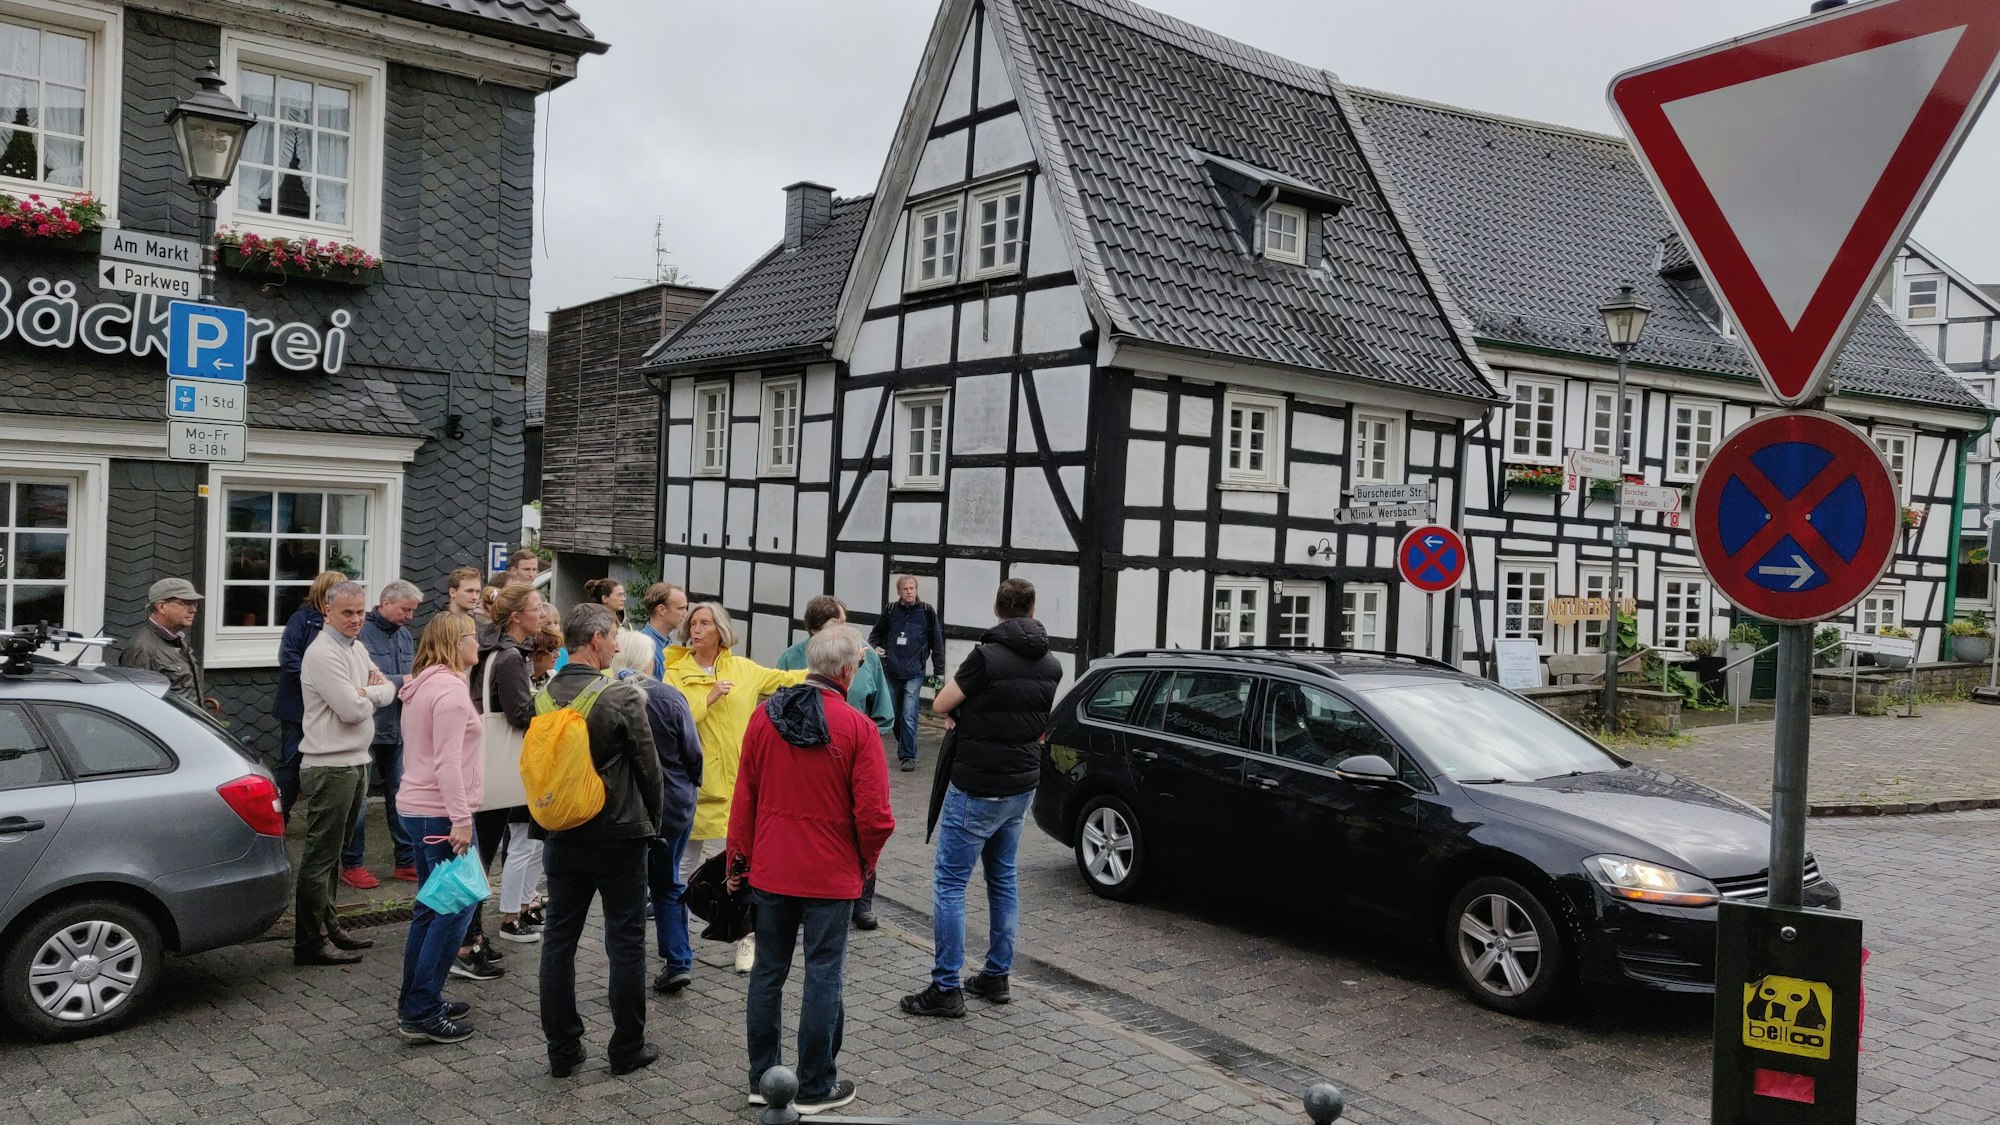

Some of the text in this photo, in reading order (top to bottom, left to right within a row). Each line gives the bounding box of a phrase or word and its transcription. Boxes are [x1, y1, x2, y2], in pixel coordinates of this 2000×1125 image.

[113, 235, 189, 262] Am Markt
[124, 268, 189, 297] Parkweg
[0, 276, 351, 375] äckrei
[187, 313, 229, 369] P
[212, 396, 238, 409] Std.
[185, 427, 229, 441] Mo-Fr
[1357, 486, 1424, 499] Burscheider Str.
[1350, 506, 1417, 520] Klinik Wersbach
